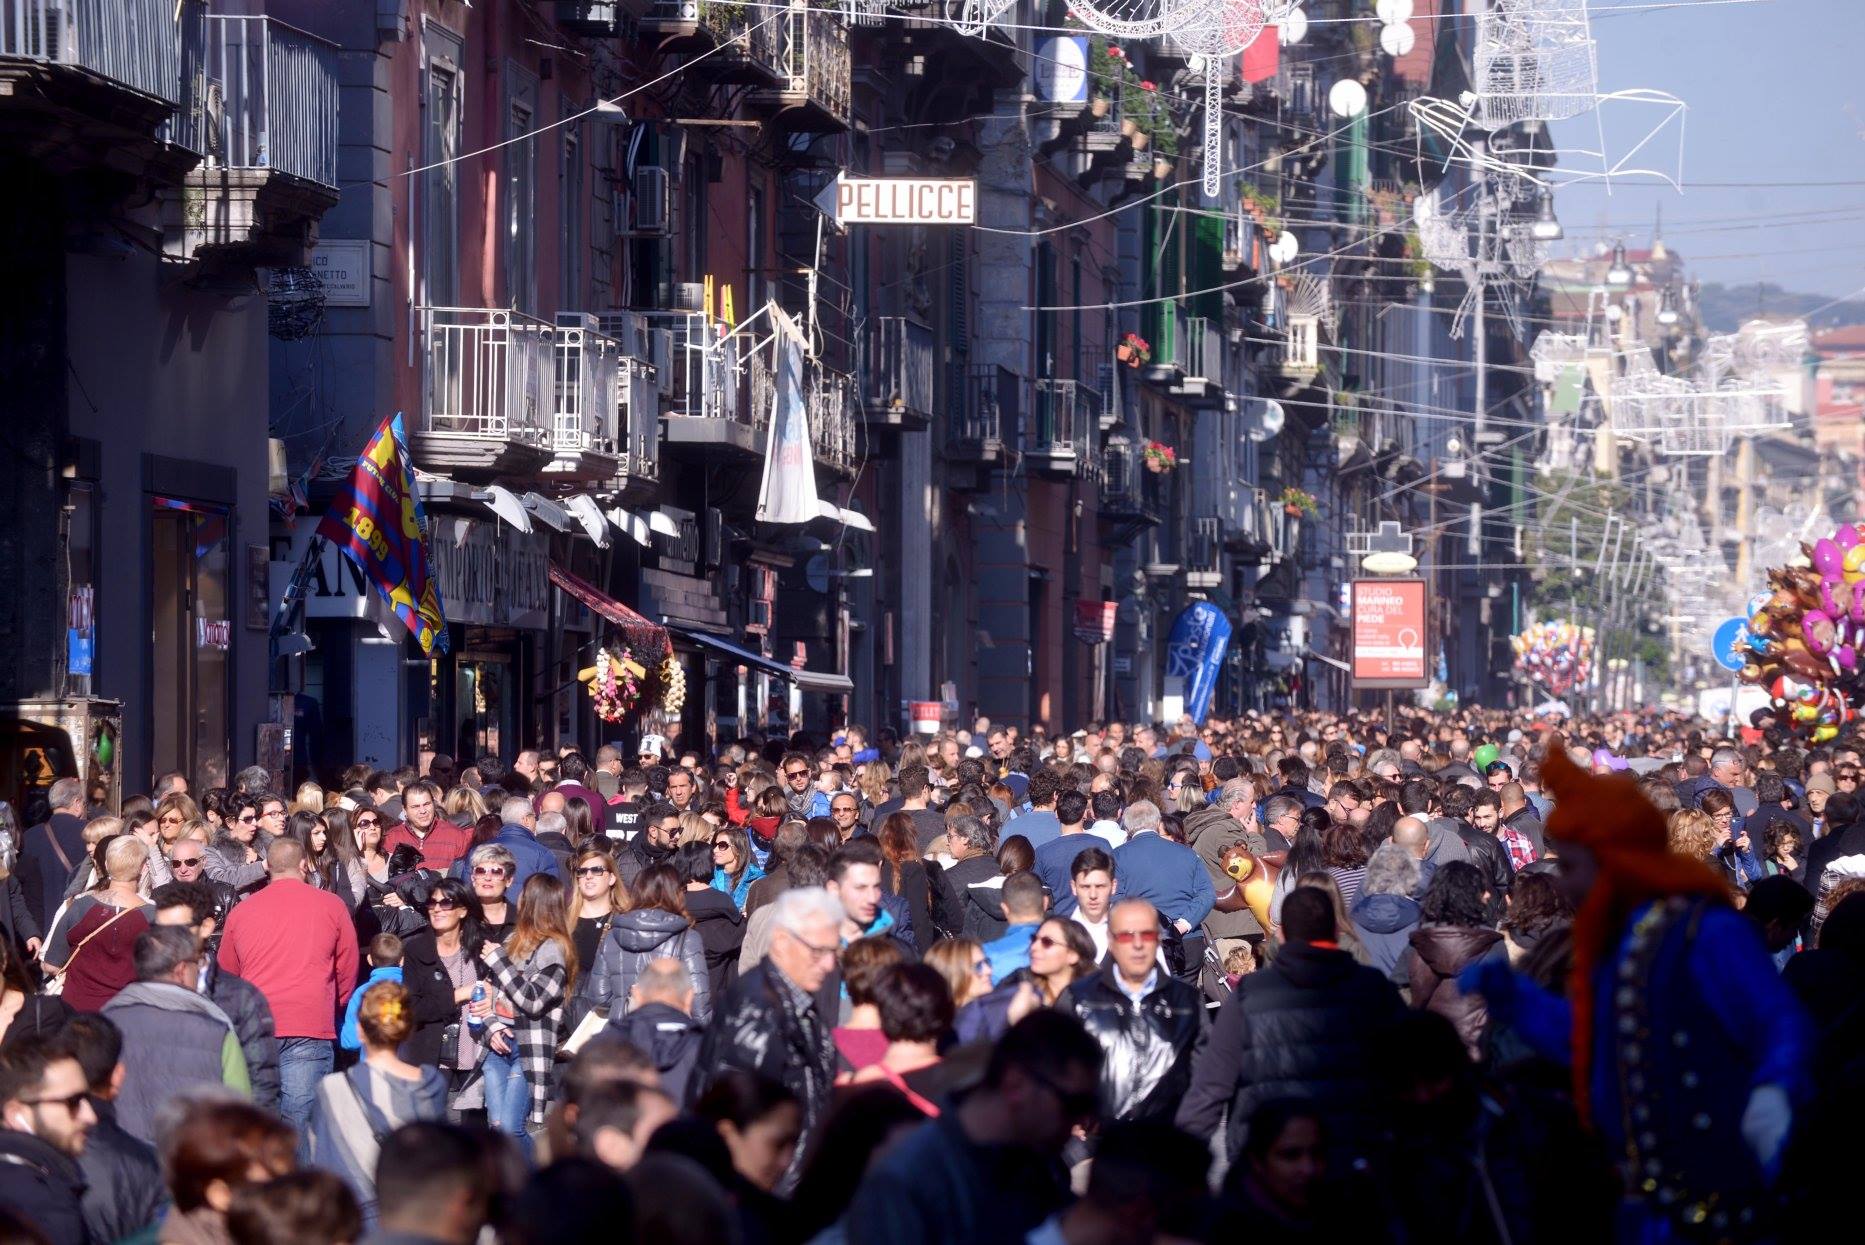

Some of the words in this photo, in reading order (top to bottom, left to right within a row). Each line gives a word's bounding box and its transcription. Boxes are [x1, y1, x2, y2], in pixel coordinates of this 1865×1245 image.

[837, 183, 971, 219] PELLICCE
[315, 270, 347, 280] NETTO
[342, 506, 389, 562] 1899
[615, 813, 638, 824] WEST
